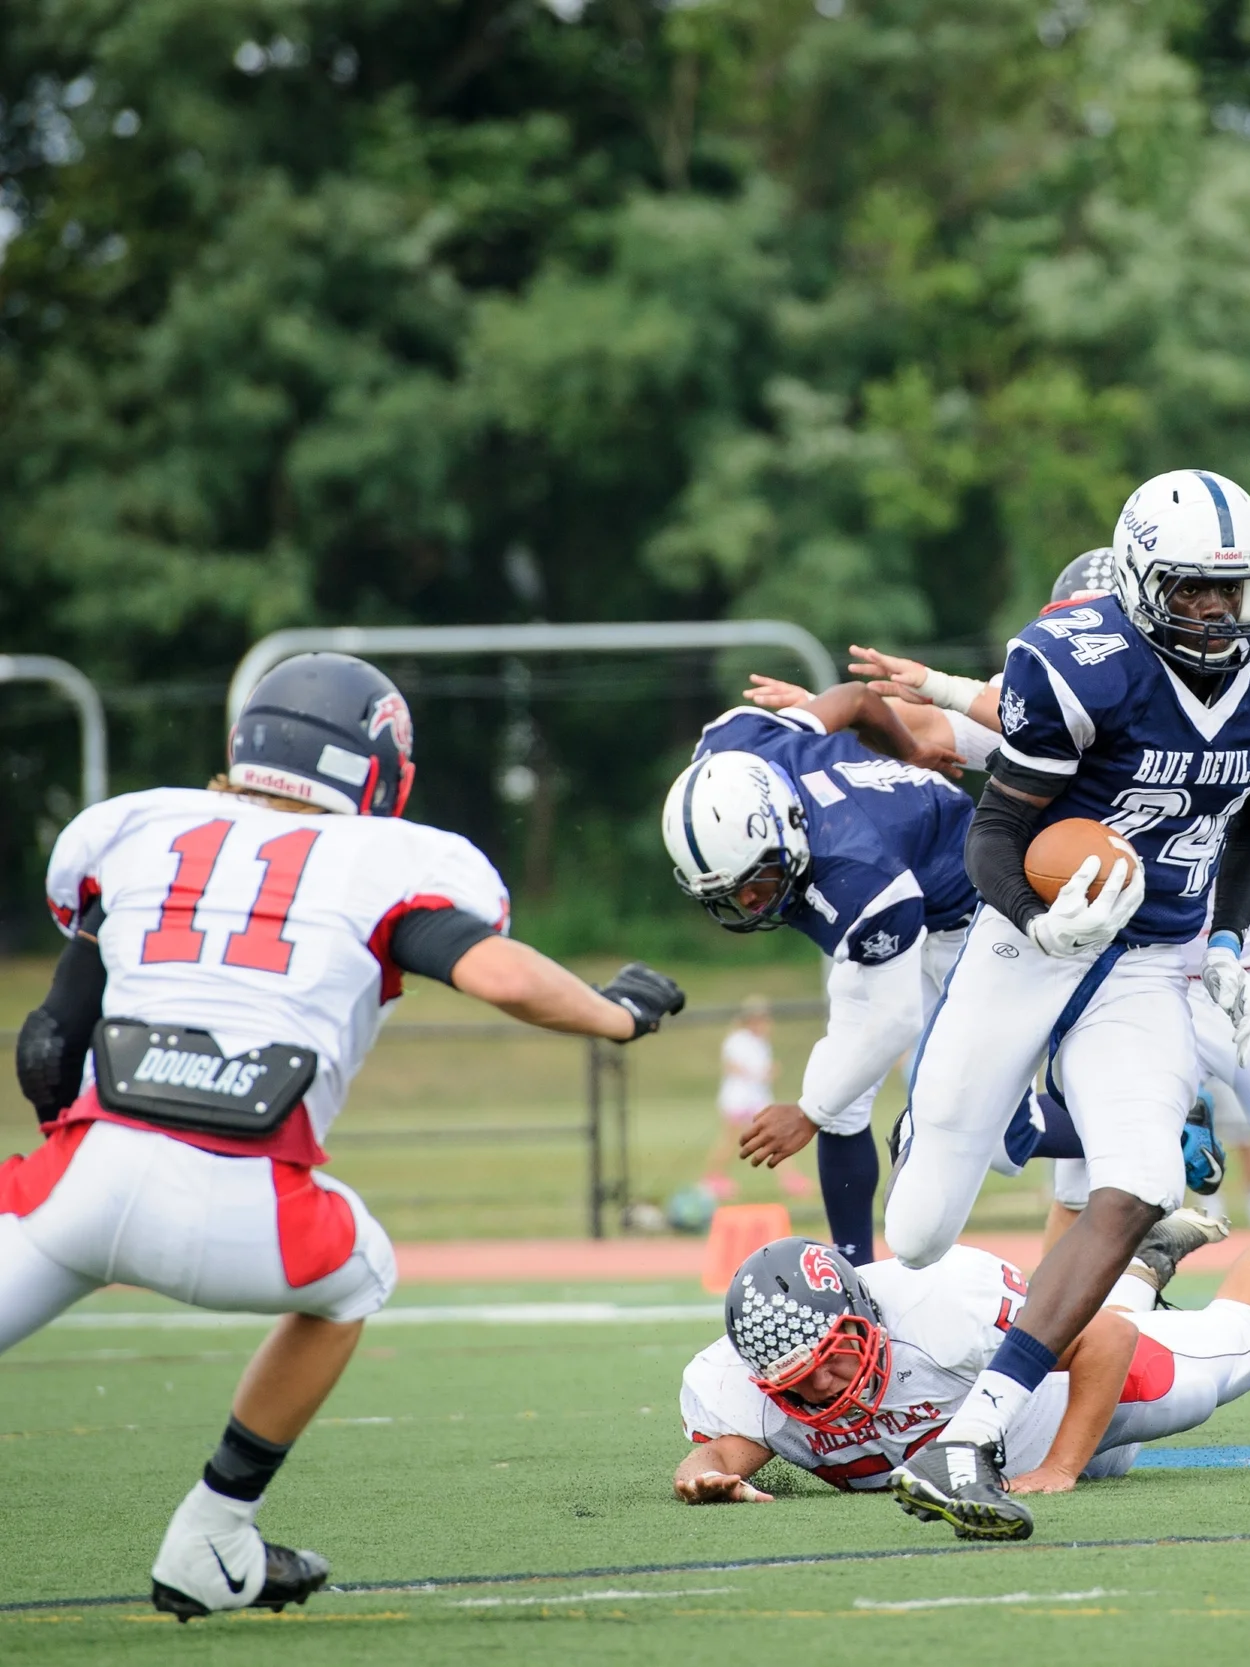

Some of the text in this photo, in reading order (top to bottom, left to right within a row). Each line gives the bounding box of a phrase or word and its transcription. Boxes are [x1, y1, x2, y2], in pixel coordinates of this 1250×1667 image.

[1214, 551, 1243, 561] Riddell
[1035, 607, 1130, 666] 24
[245, 769, 312, 799] Riddell
[1132, 748, 1194, 785] BLUE
[139, 818, 321, 975] 11
[133, 1047, 261, 1098] DOUGLAS
[774, 1352, 800, 1369] Riddell
[805, 1400, 941, 1456] MILLER PLACE
